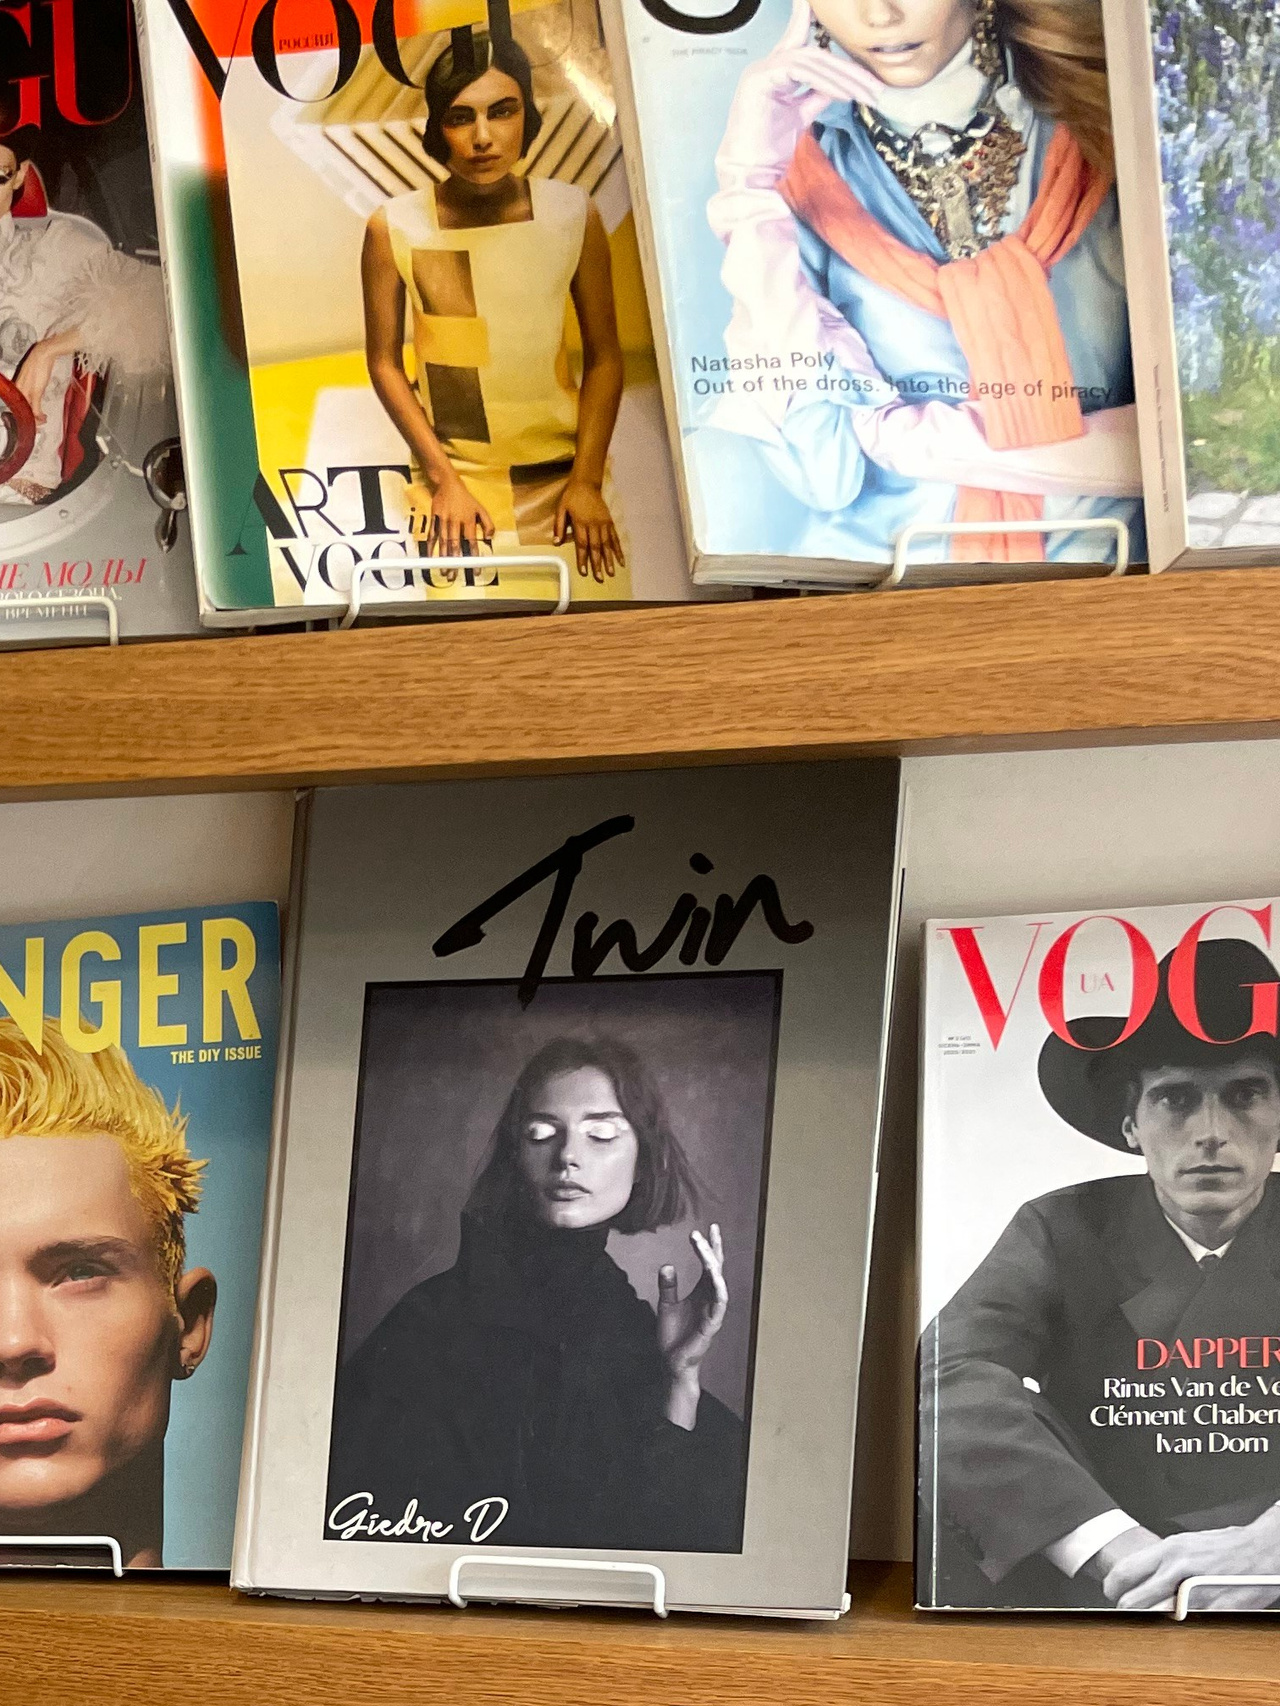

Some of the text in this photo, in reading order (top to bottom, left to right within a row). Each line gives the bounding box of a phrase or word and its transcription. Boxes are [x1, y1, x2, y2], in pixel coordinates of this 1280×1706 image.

[691, 350, 836, 373] Natasha Poly
[693, 376, 739, 397] Out
[743, 376, 766, 393] of
[773, 375, 808, 393] the
[815, 376, 881, 394] dross.
[937, 377, 970, 395] the
[978, 381, 1016, 399] age
[1023, 379, 1044, 397] of
[226, 464, 412, 555] ART
[39, 557, 148, 590] МОДЫ
[431, 814, 814, 1010] Twin
[1080, 972, 1115, 994] UA
[170, 1045, 262, 1065] THE DIY ISSUE
[1137, 1336, 1280, 1370] DAPPER
[1103, 1377, 1166, 1399] Rinus
[1170, 1376, 1214, 1398] Van
[1219, 1375, 1252, 1397] de
[1089, 1404, 1188, 1427] Clément
[1156, 1431, 1269, 1454] Ivan Dorn
[463, 1496, 510, 1543] D
